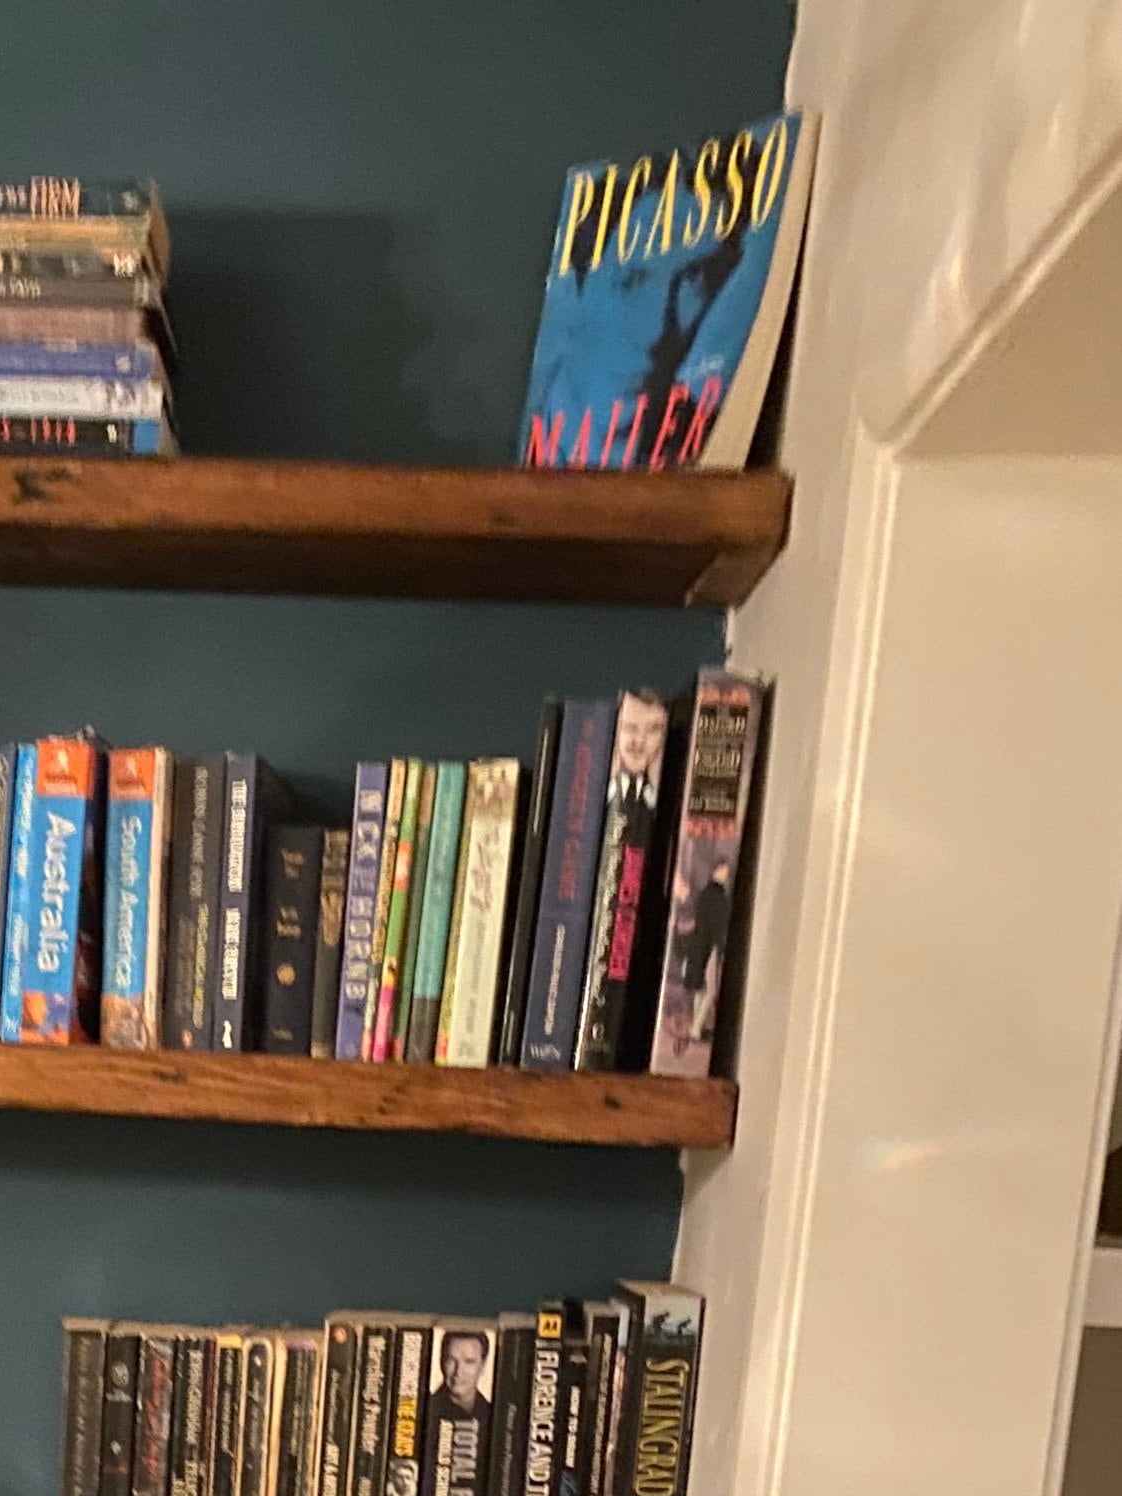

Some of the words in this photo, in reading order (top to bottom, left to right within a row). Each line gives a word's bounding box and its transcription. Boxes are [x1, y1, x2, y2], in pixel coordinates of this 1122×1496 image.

[30, 174, 80, 219] FIRM
[557, 117, 787, 278] PICASSO
[120, 814, 143, 884] South
[36, 811, 78, 973] Australia
[115, 888, 139, 987] America
[530, 1350, 559, 1446] FLORENCE
[437, 1419, 453, 1465] ARNOLD
[451, 1418, 478, 1484] TOTAL
[527, 1443, 553, 1486] AND
